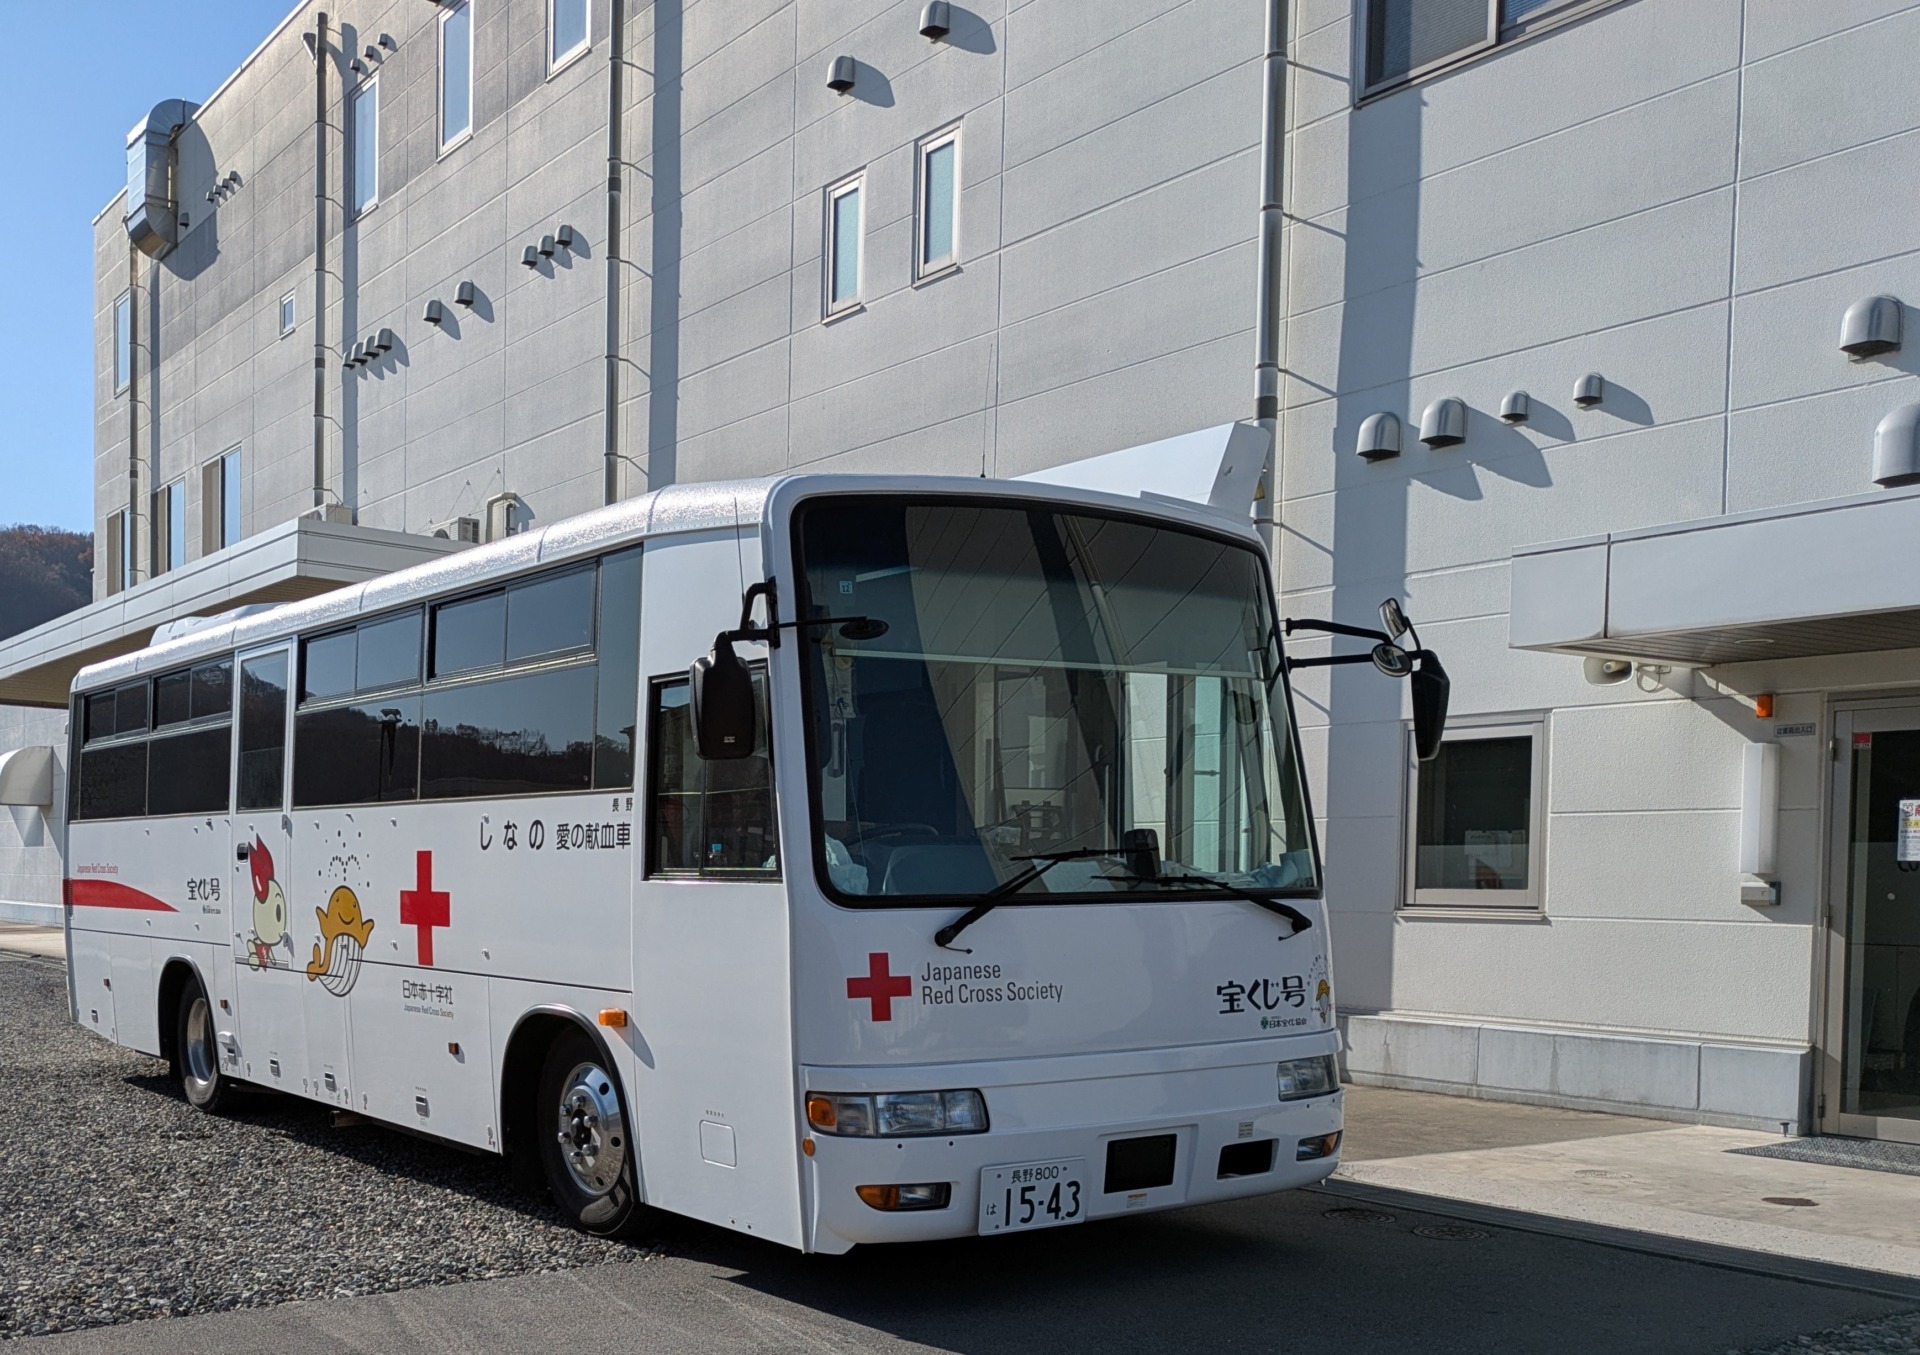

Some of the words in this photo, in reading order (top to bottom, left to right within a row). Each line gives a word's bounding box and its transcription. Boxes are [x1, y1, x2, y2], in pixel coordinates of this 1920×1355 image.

[612, 797, 633, 812] 長野
[480, 819, 545, 851] しなの
[556, 821, 631, 850] 愛の献血車
[187, 877, 221, 901] 宝くじ号
[921, 962, 1001, 985] Japanese
[402, 979, 454, 1005] 日本赤十字社
[922, 985, 954, 1005] Red
[958, 983, 1003, 1004] Cross
[1006, 981, 1063, 1003] Society
[1216, 975, 1306, 1014] 宝くじ号
[404, 1003, 421, 1014] Japanese
[421, 1005, 429, 1015] Red
[429, 1006, 440, 1016] Cross
[440, 1008, 454, 1020] Society
[986, 1202, 997, 1216] は
[1005, 1180, 1081, 1227] 15-43
